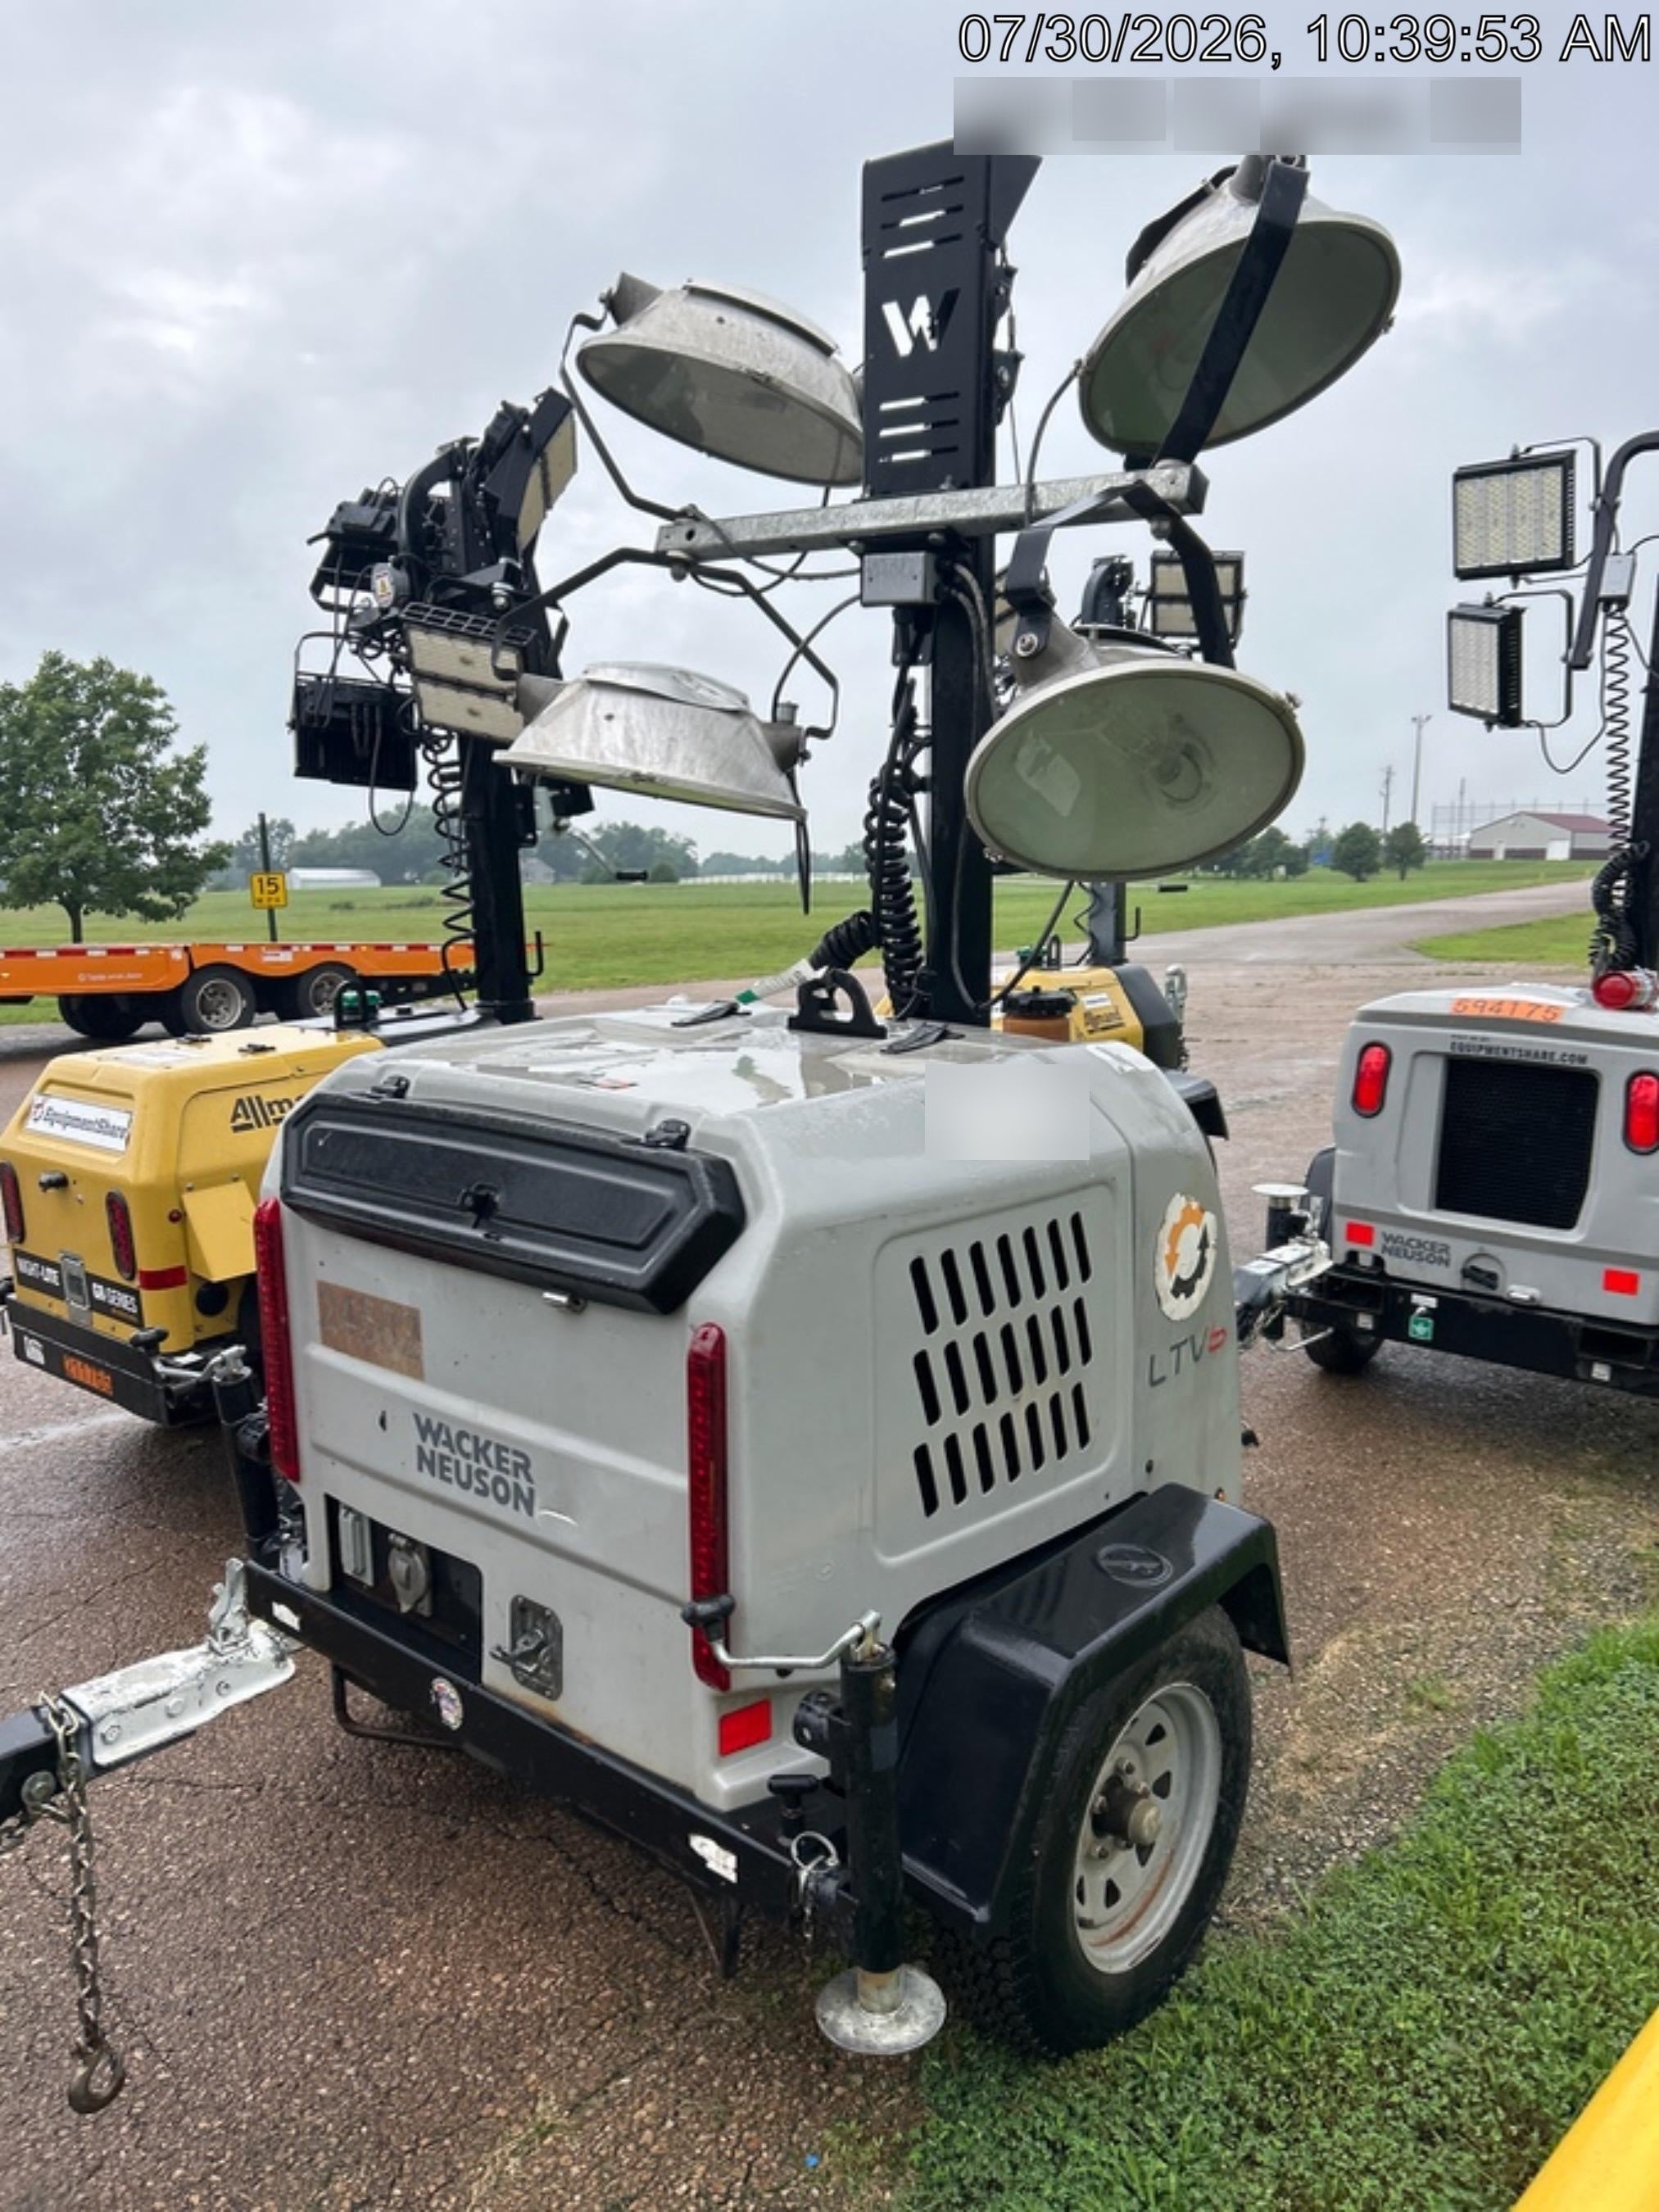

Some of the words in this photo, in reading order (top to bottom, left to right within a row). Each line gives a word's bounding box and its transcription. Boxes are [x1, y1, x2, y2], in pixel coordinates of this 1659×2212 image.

[881, 288, 960, 357] W
[256, 877, 279, 895] 15
[1453, 999, 1557, 1022] 594175
[1450, 1041, 1589, 1064] EQUIPMENTSHARE.COM
[230, 1094, 304, 1133] Allm
[1381, 1231, 1451, 1255] WACKER
[1381, 1244, 1451, 1267] NEUSON
[412, 1412, 535, 1484] WACKER
[416, 1444, 536, 1517] NEUSON
